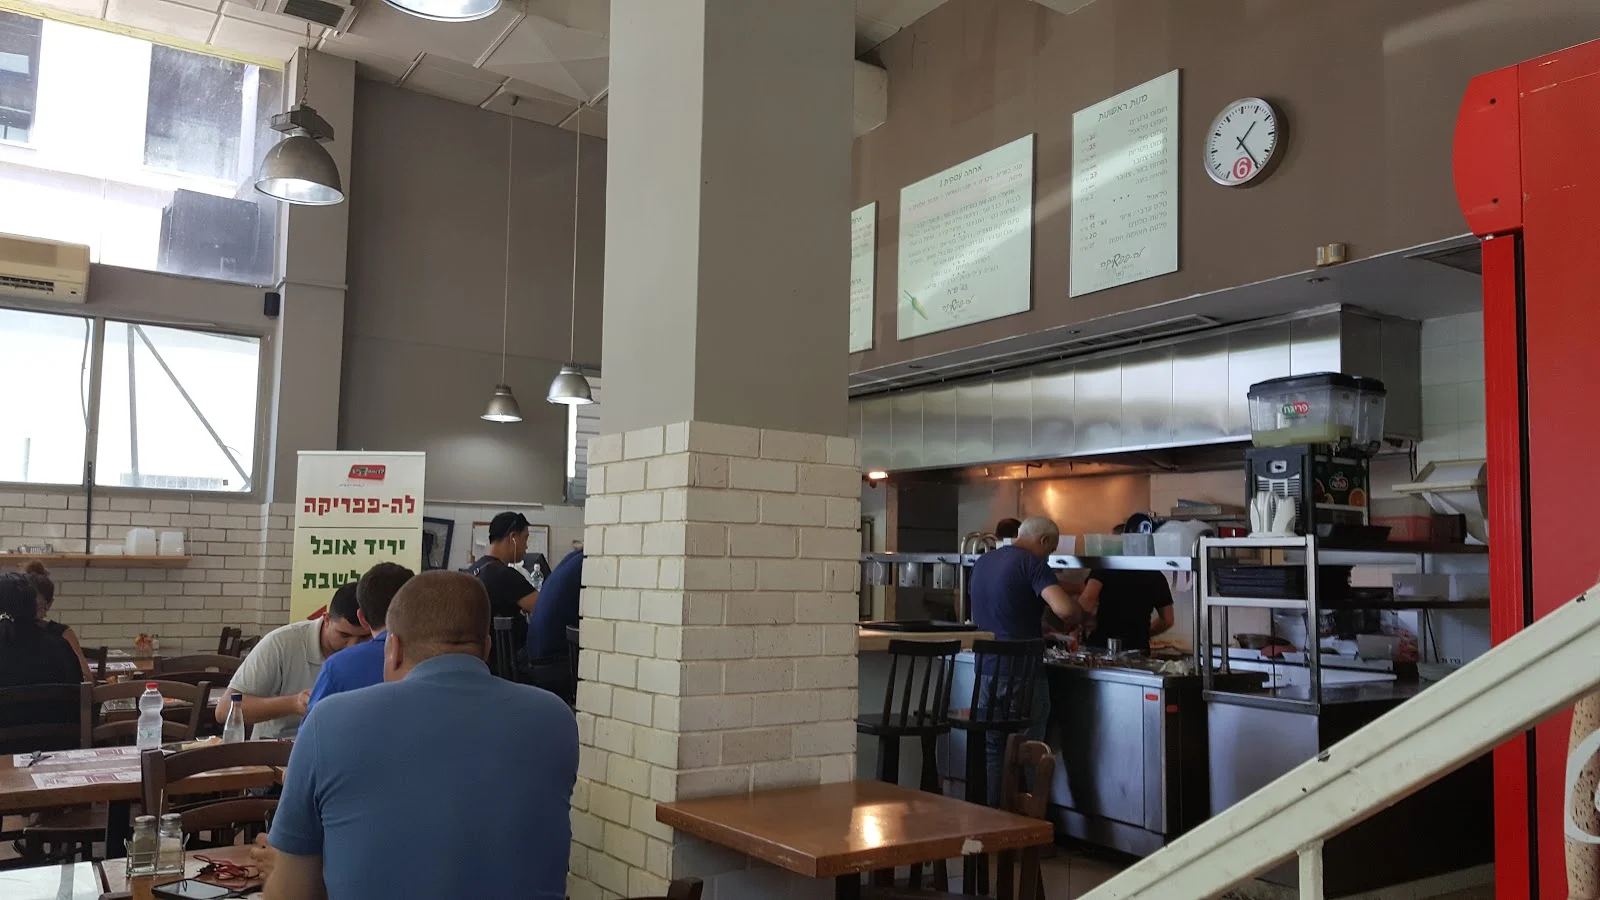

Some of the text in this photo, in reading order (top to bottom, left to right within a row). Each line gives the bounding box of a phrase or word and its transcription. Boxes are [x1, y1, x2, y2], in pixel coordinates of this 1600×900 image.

[1098, 94, 1147, 120] מנות ראשונות
[1128, 123, 1148, 135] פלאפל
[1236, 160, 1250, 177] 6
[1146, 189, 1167, 200] פלאפל
[1153, 200, 1167, 209] סלט
[304, 495, 415, 516] לה-פפריקה
[310, 536, 406, 555] יריד אוכל
